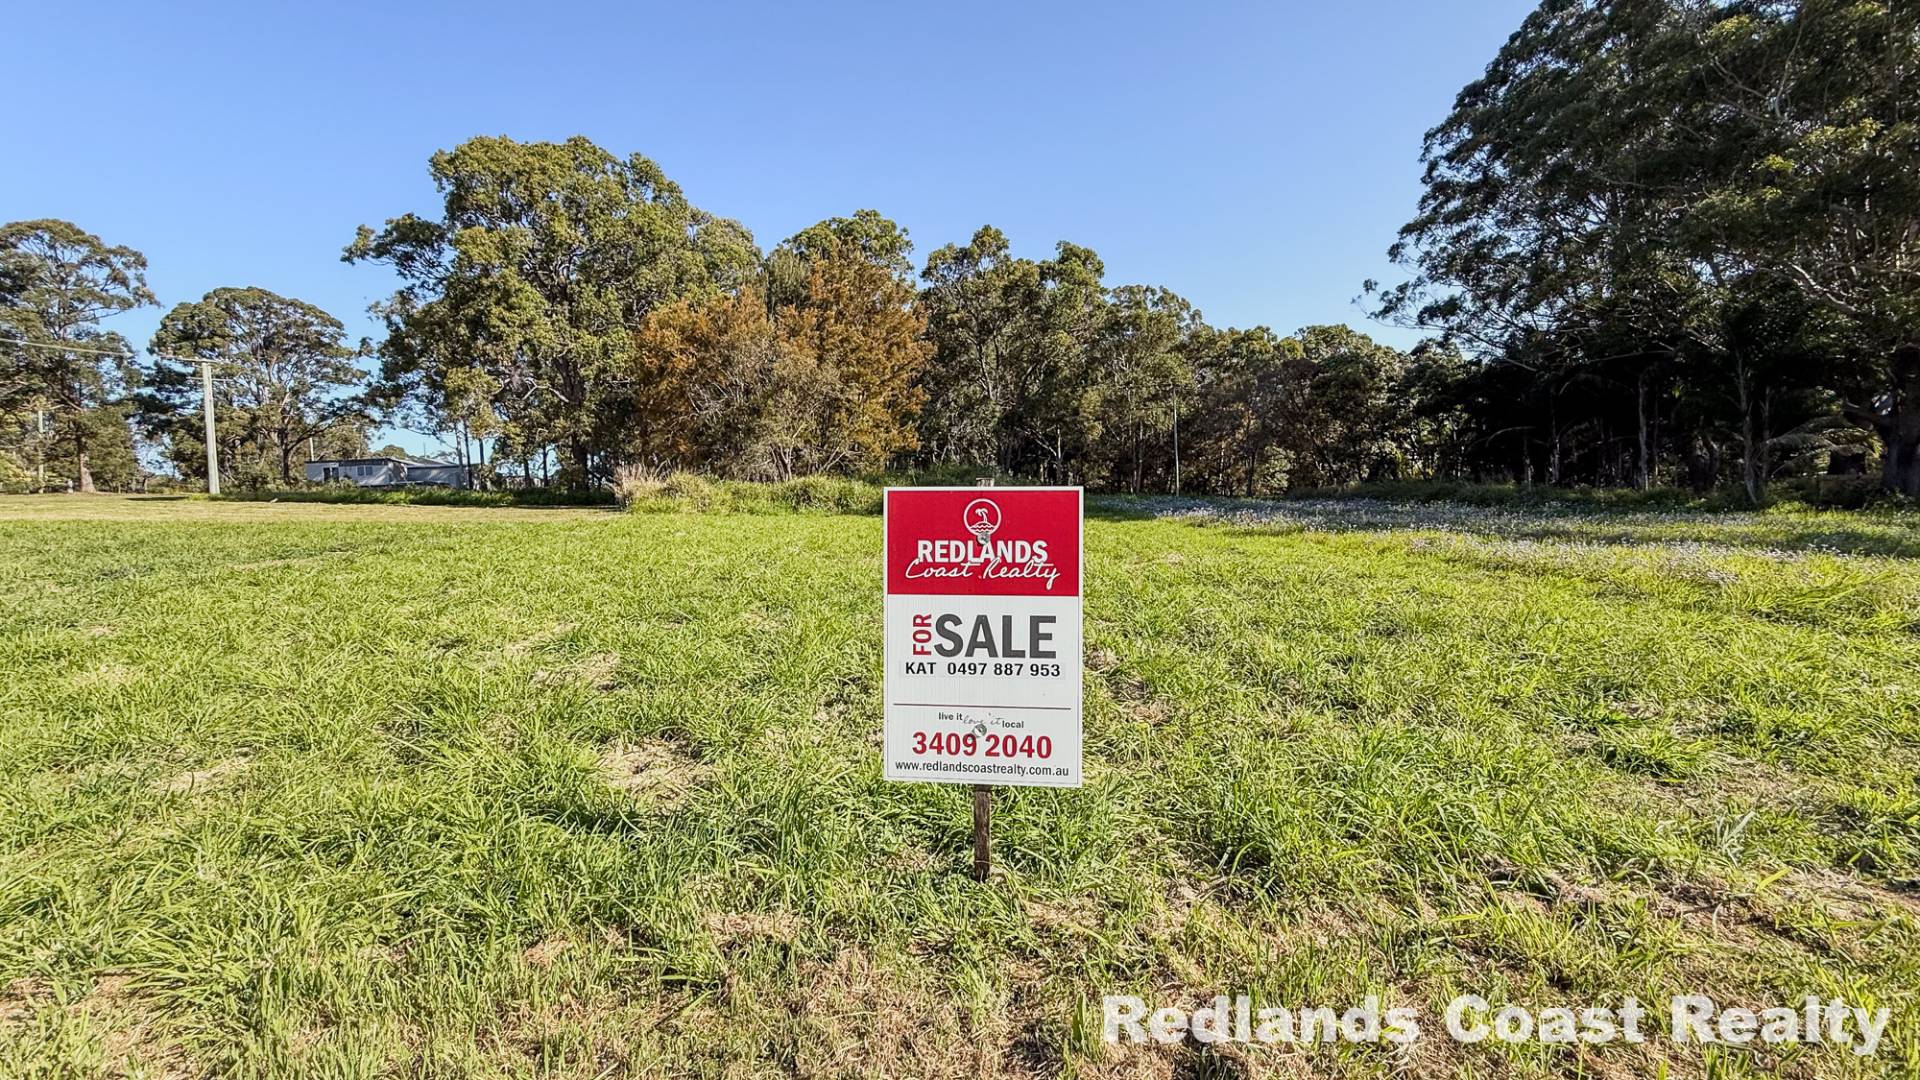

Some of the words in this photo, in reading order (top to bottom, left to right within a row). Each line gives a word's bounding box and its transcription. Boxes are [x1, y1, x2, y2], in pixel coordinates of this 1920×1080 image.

[918, 540, 1048, 563] REDLANDS
[905, 558, 980, 579] Coast
[983, 556, 1061, 590] Realty
[912, 614, 932, 656] FOR
[934, 613, 1057, 659] SALE
[905, 661, 937, 675] KAT
[947, 662, 988, 675] 0497
[993, 663, 1024, 676] 887
[1030, 664, 1061, 677] 953
[938, 712, 953, 720] live
[956, 713, 962, 721] it
[1002, 720, 1025, 729] local
[912, 732, 977, 757] 3409
[985, 734, 1052, 759] 2040
[895, 760, 1069, 777] www.redlandscoastrealty.com.au
